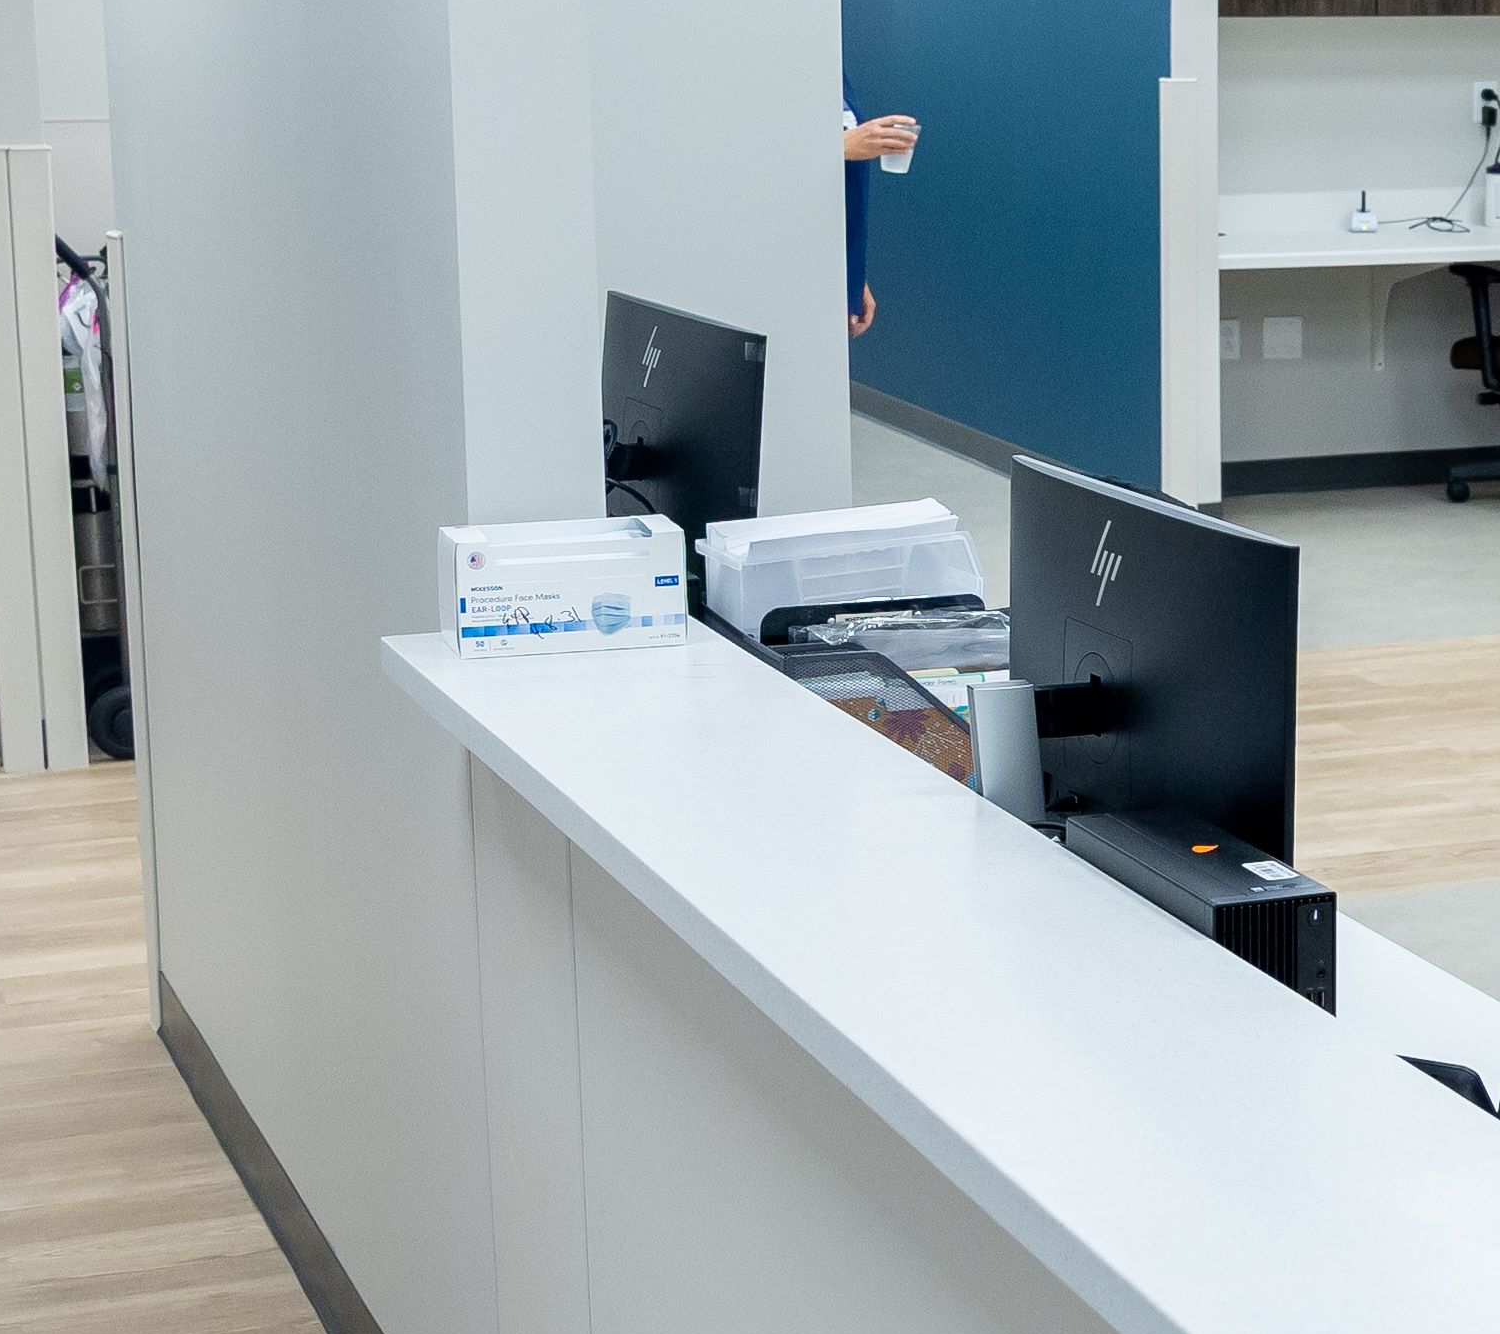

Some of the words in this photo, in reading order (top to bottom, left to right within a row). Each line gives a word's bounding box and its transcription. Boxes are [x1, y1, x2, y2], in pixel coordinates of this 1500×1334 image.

[471, 595, 513, 604] Procedure
[514, 593, 534, 602] Face
[535, 592, 561, 601] Masks
[471, 604, 512, 614] EAR-LOOP
